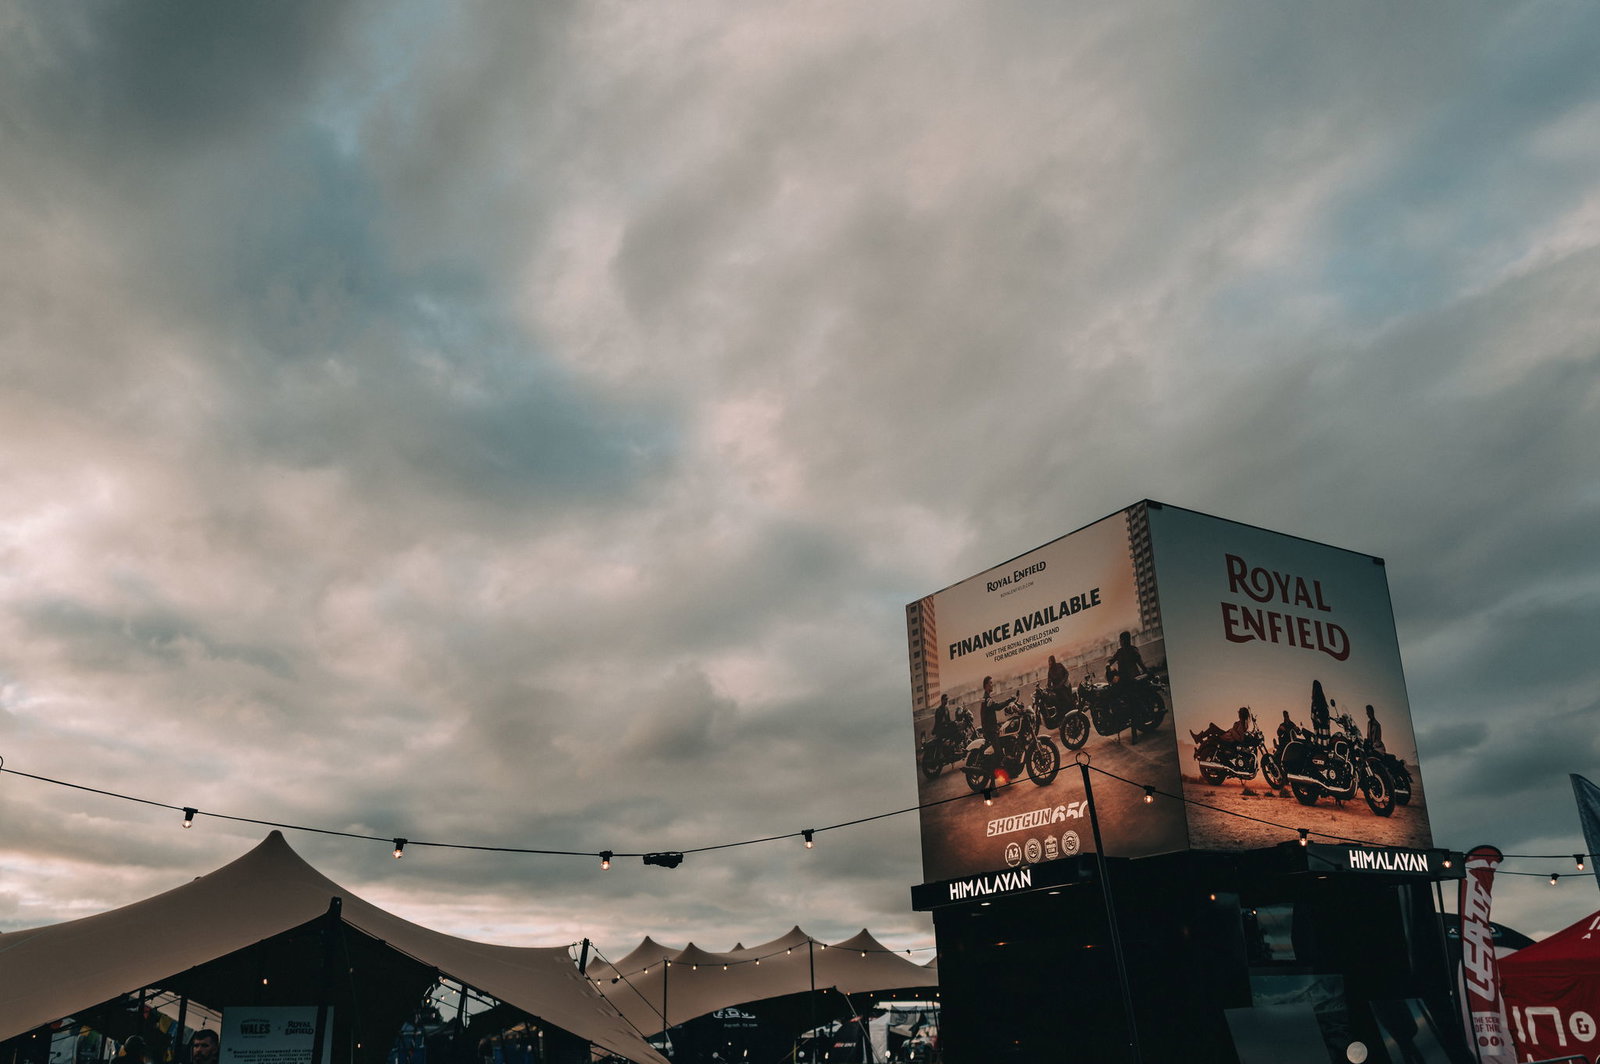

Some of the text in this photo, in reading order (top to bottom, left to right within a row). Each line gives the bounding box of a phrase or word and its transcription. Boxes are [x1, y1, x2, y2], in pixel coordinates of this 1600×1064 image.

[949, 588, 1102, 660] FINANCE AVAILABLE
[985, 626, 1060, 658] VISIT THE ROYAL ENFIELD STAND
[994, 637, 1053, 662] FOR MORE INFORMATION
[988, 810, 1050, 835] SHOTGUN
[1008, 847, 1019, 859] A2
[1349, 850, 1430, 873] HIMALAYAN
[949, 869, 1033, 901] HIMALAYAN
[240, 1023, 271, 1034] WALES
